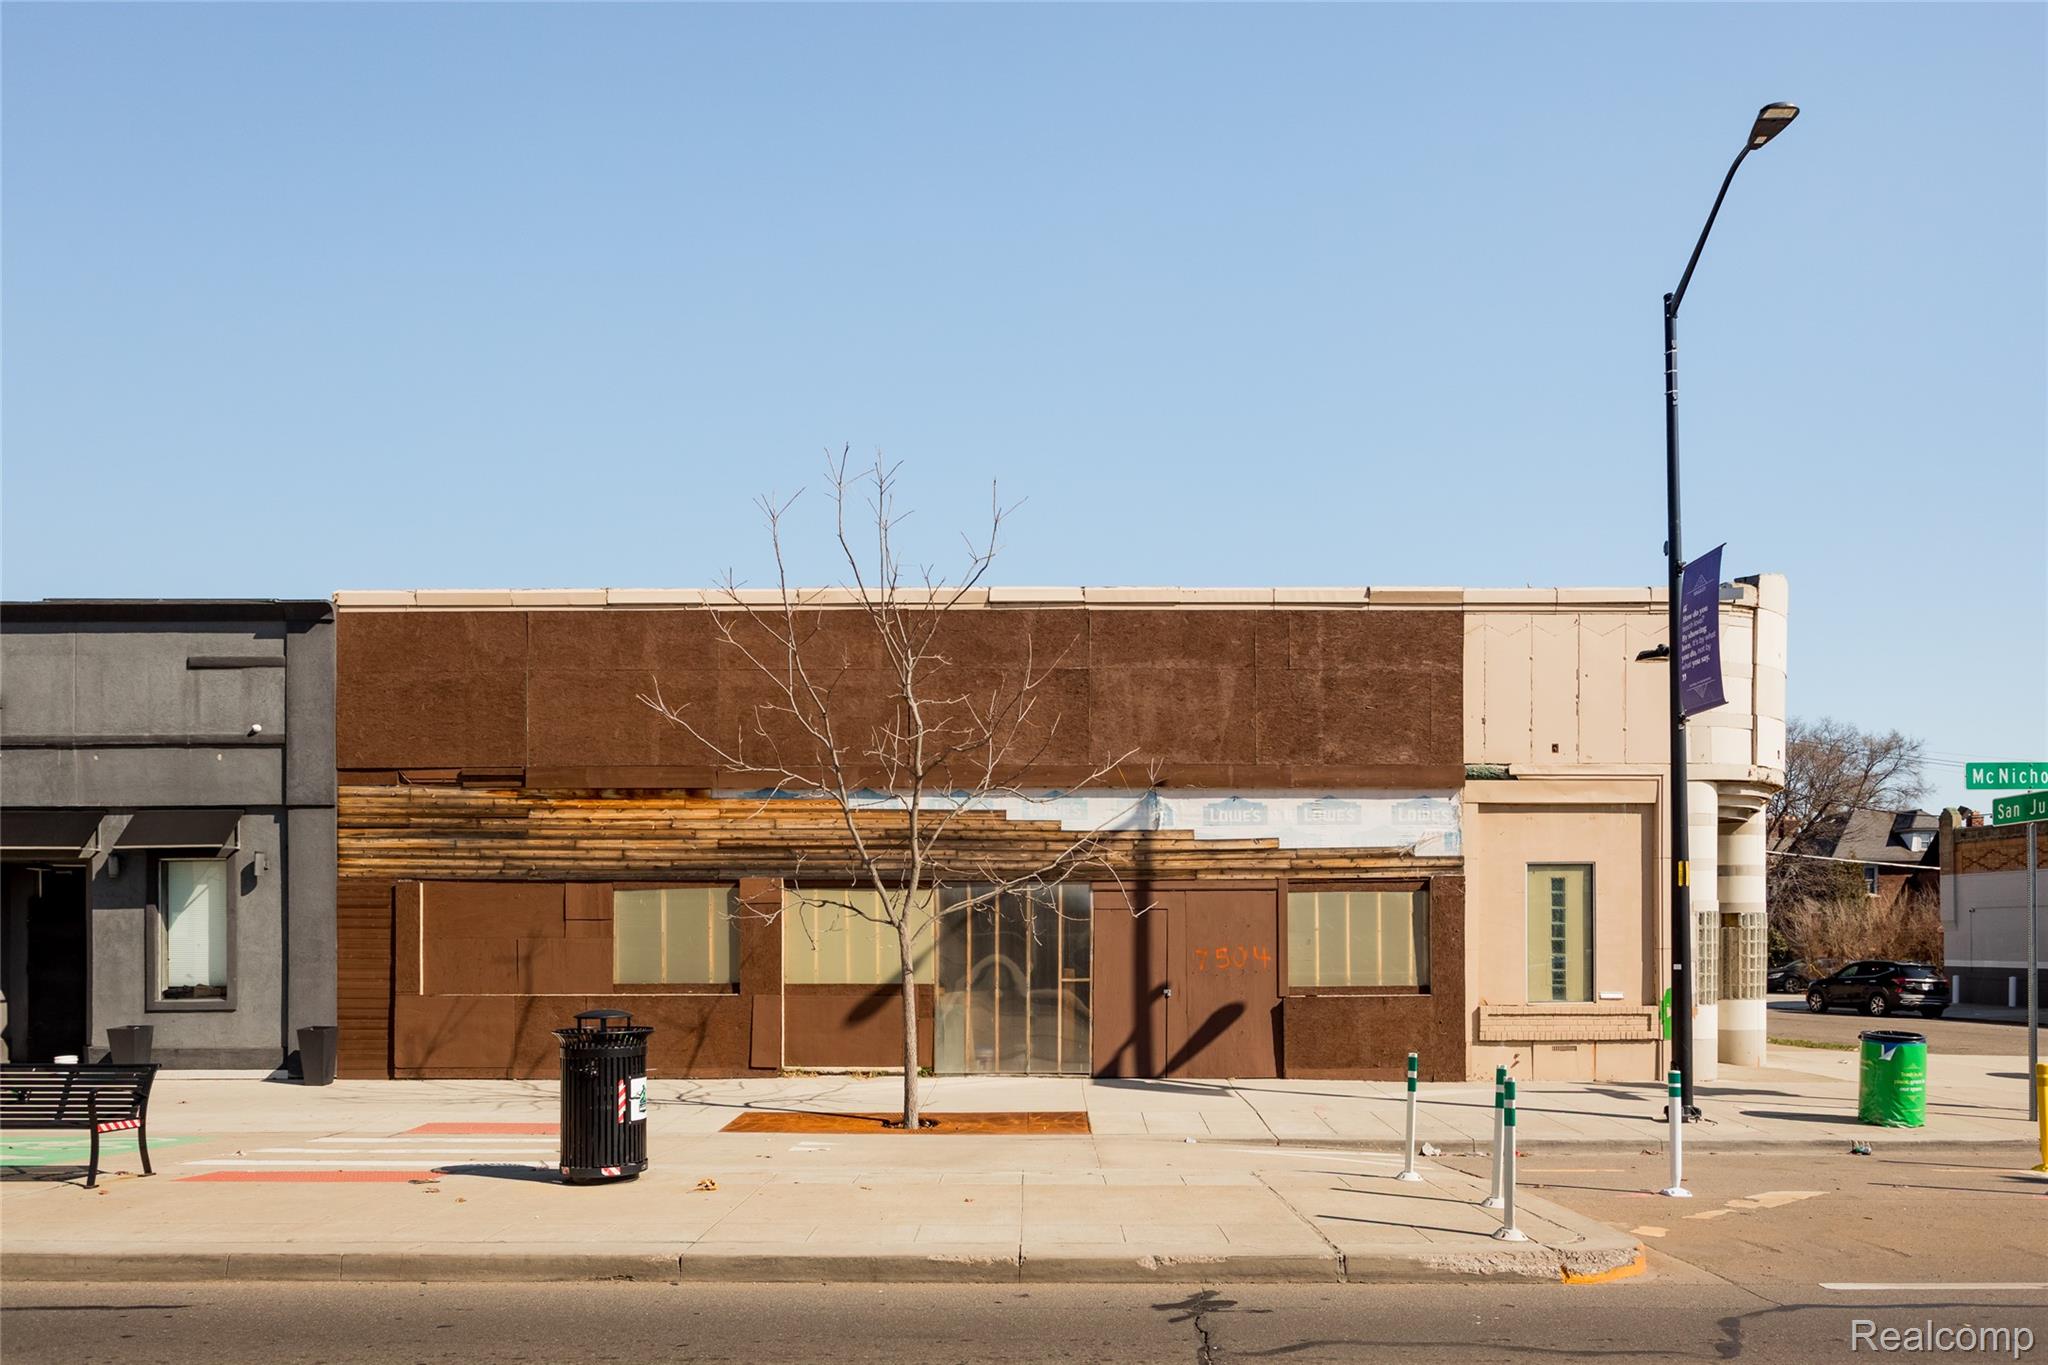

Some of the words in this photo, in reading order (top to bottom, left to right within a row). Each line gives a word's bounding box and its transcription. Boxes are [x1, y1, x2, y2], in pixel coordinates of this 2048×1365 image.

[1972, 768, 2048, 784] McNicho
[1997, 803, 2020, 819] San
[2029, 799, 2046, 815] Ju
[1194, 943, 1271, 971] 7504
